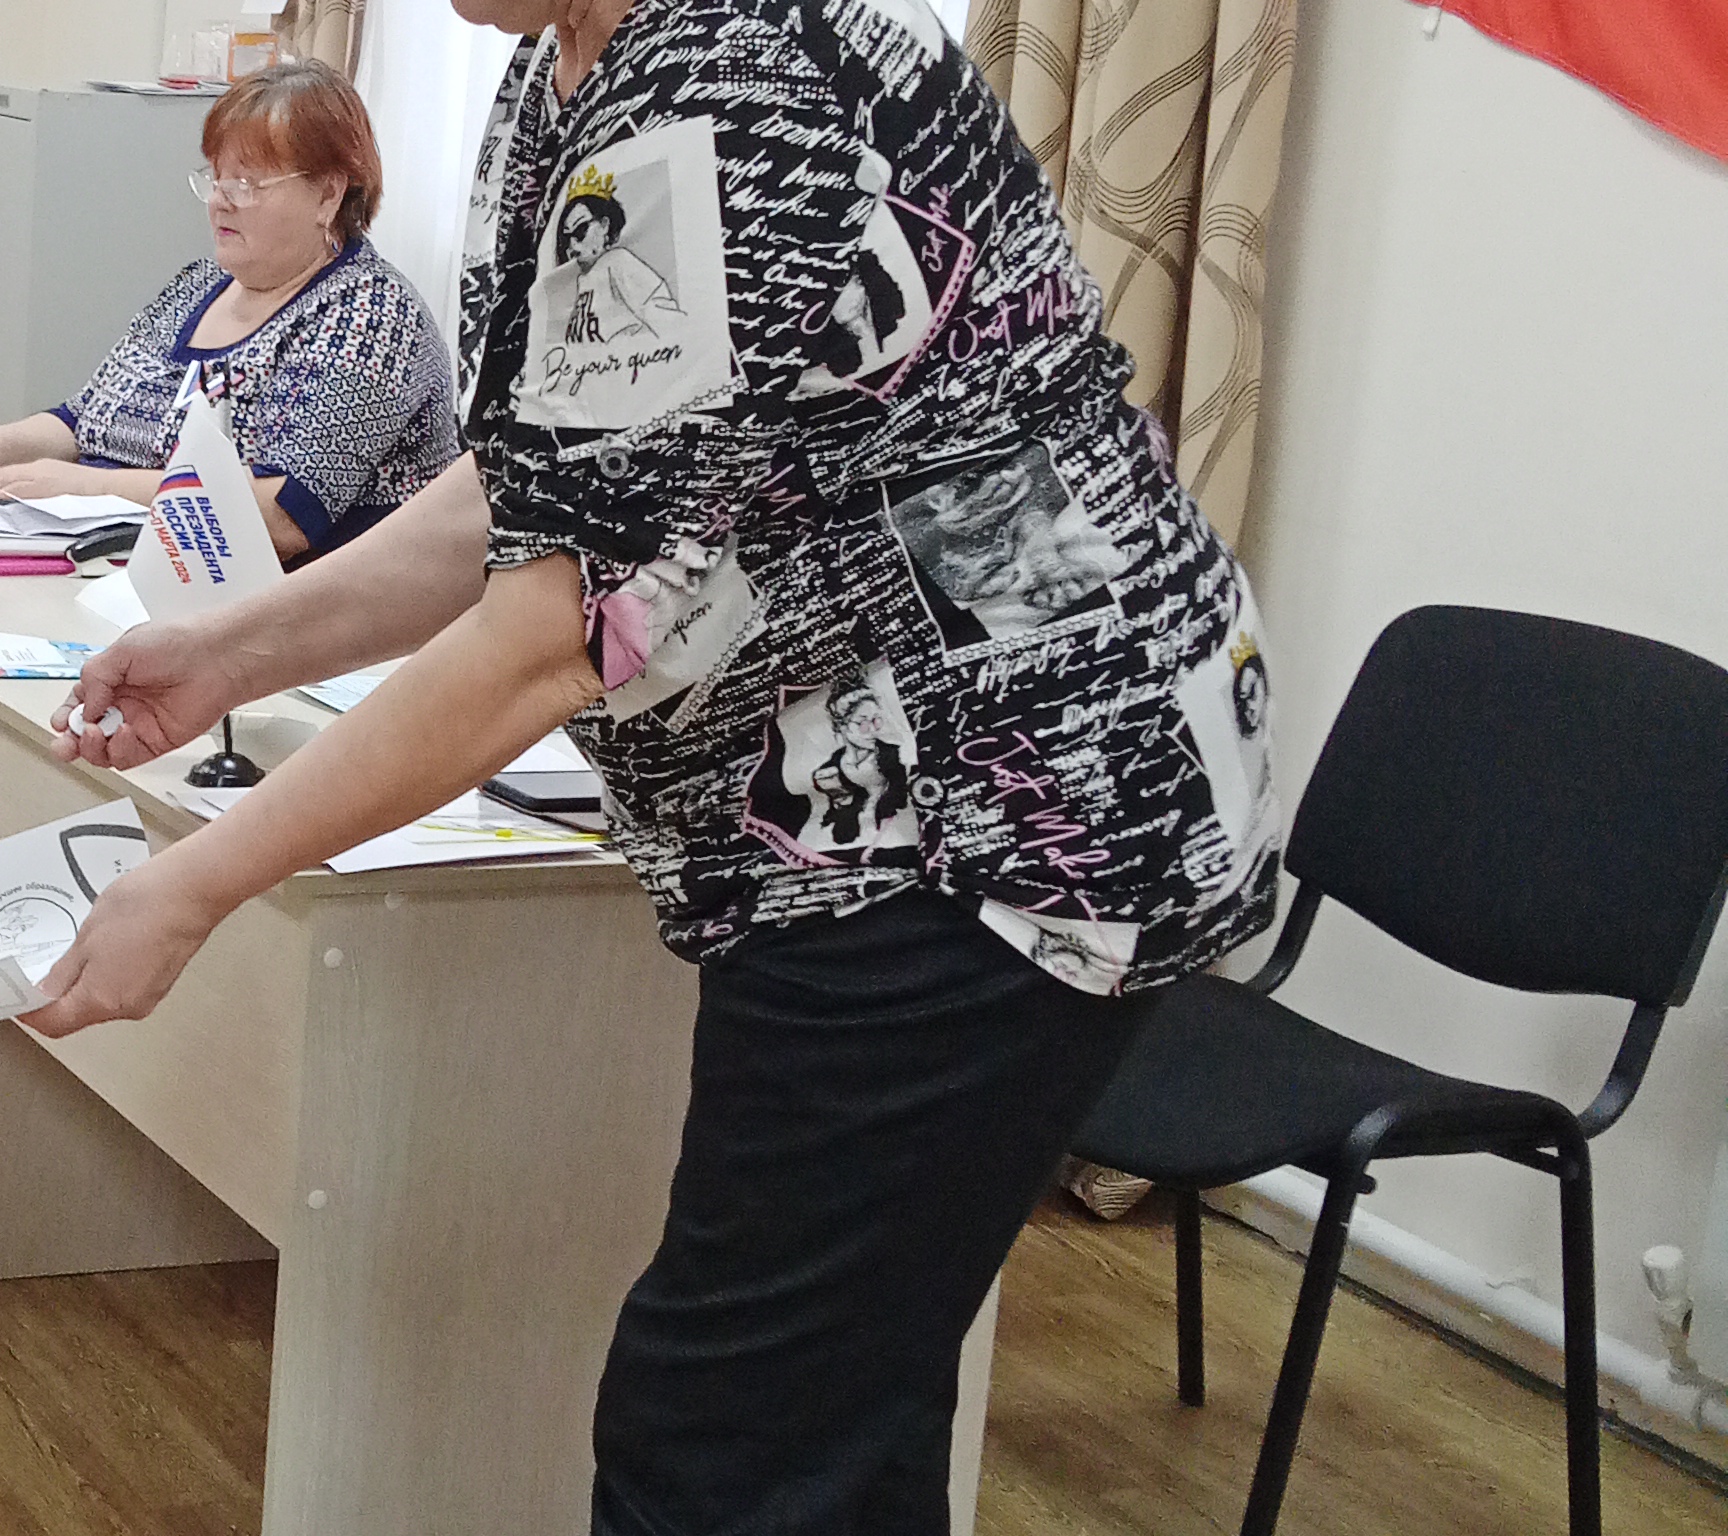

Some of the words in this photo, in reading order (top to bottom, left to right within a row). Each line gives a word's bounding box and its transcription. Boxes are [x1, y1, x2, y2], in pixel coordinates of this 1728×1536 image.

[538, 347, 572, 396] Be
[569, 354, 621, 396] your
[628, 345, 682, 385] queen
[154, 525, 181, 559] МАРТА
[171, 560, 192, 585] 2024
[158, 499, 194, 551] РОССИИ
[175, 496, 226, 584] ПРЕЗИДЕНТА
[195, 496, 232, 558] ВЫБОРЫ
[956, 730, 1056, 805] Just
[1018, 803, 1112, 880] Make
